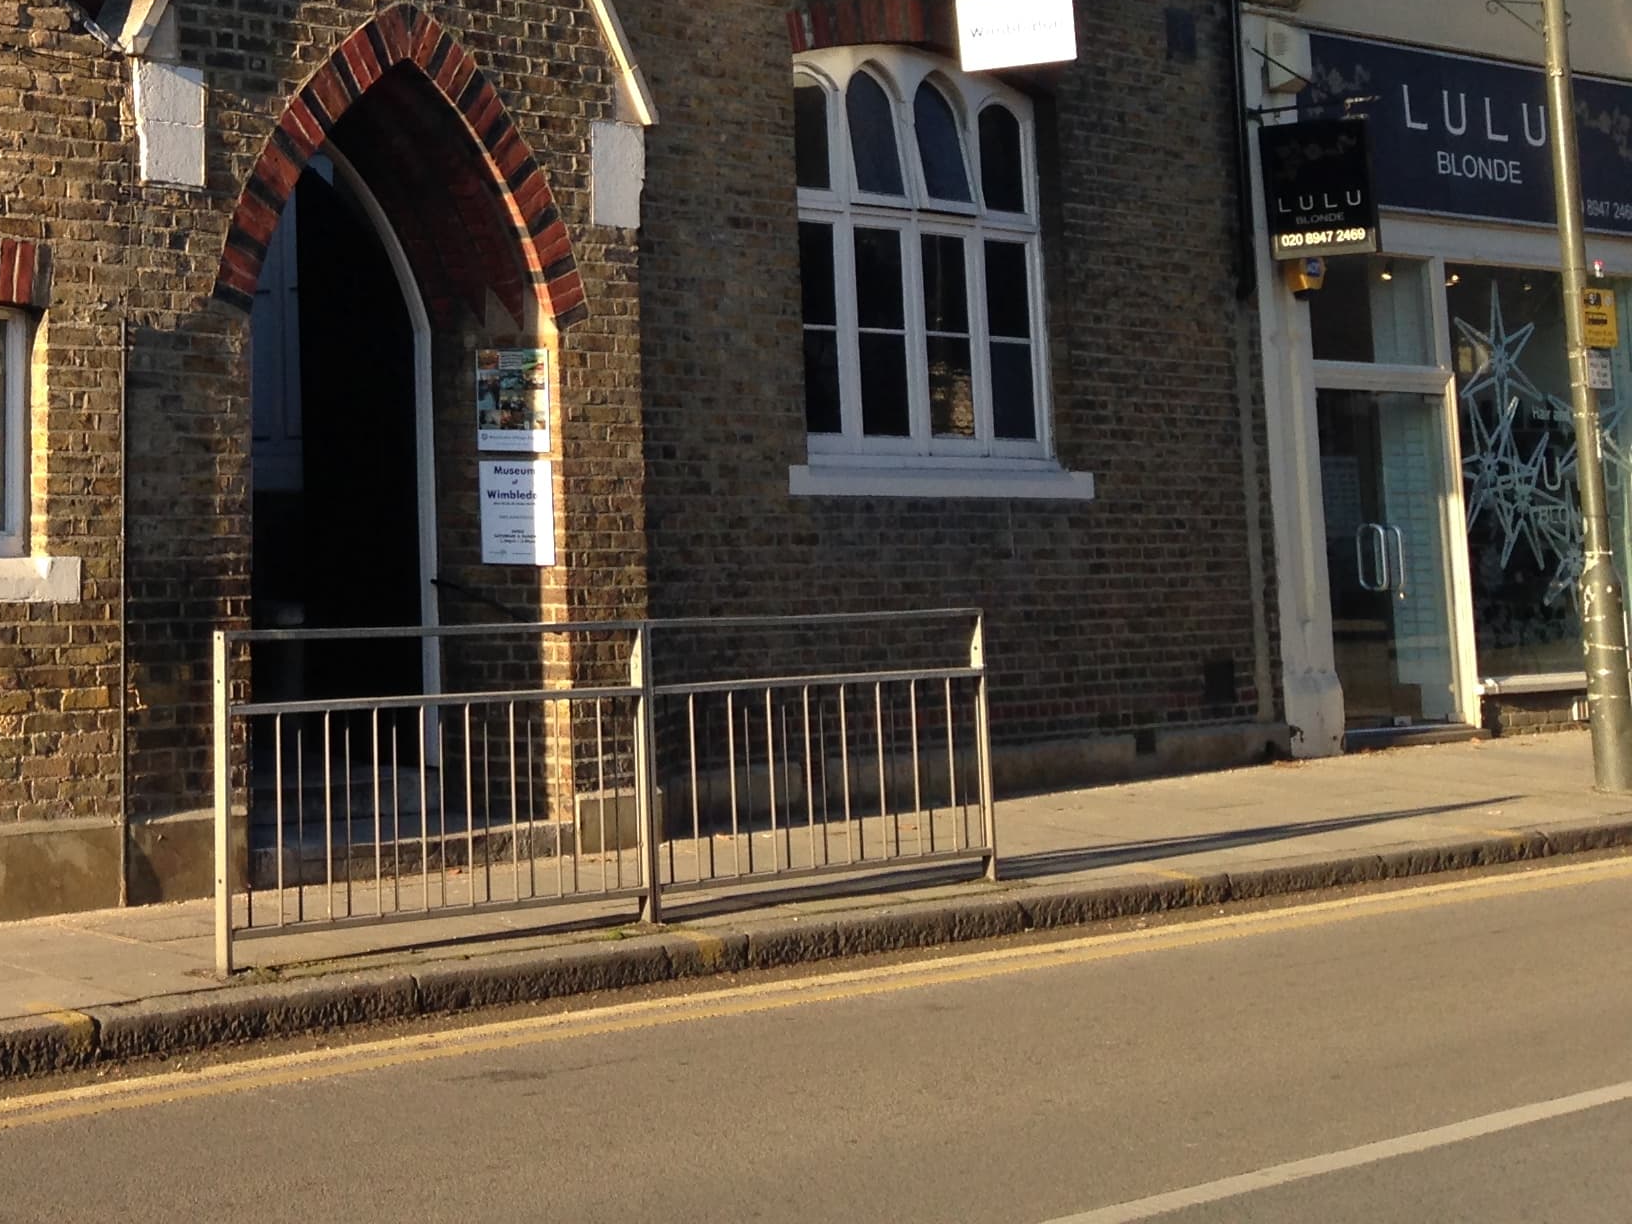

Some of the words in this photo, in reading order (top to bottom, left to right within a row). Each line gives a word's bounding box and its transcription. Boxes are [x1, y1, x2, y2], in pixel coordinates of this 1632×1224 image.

[1402, 84, 1546, 147] LULU
[1437, 150, 1523, 184] BLONDE
[1278, 189, 1361, 213] LULU
[1296, 211, 1344, 224] BLONDE
[1281, 233, 1303, 246] 020
[1305, 230, 1334, 245] 8947
[1336, 227, 1366, 242] 2469
[487, 489, 537, 500] Wimbled
